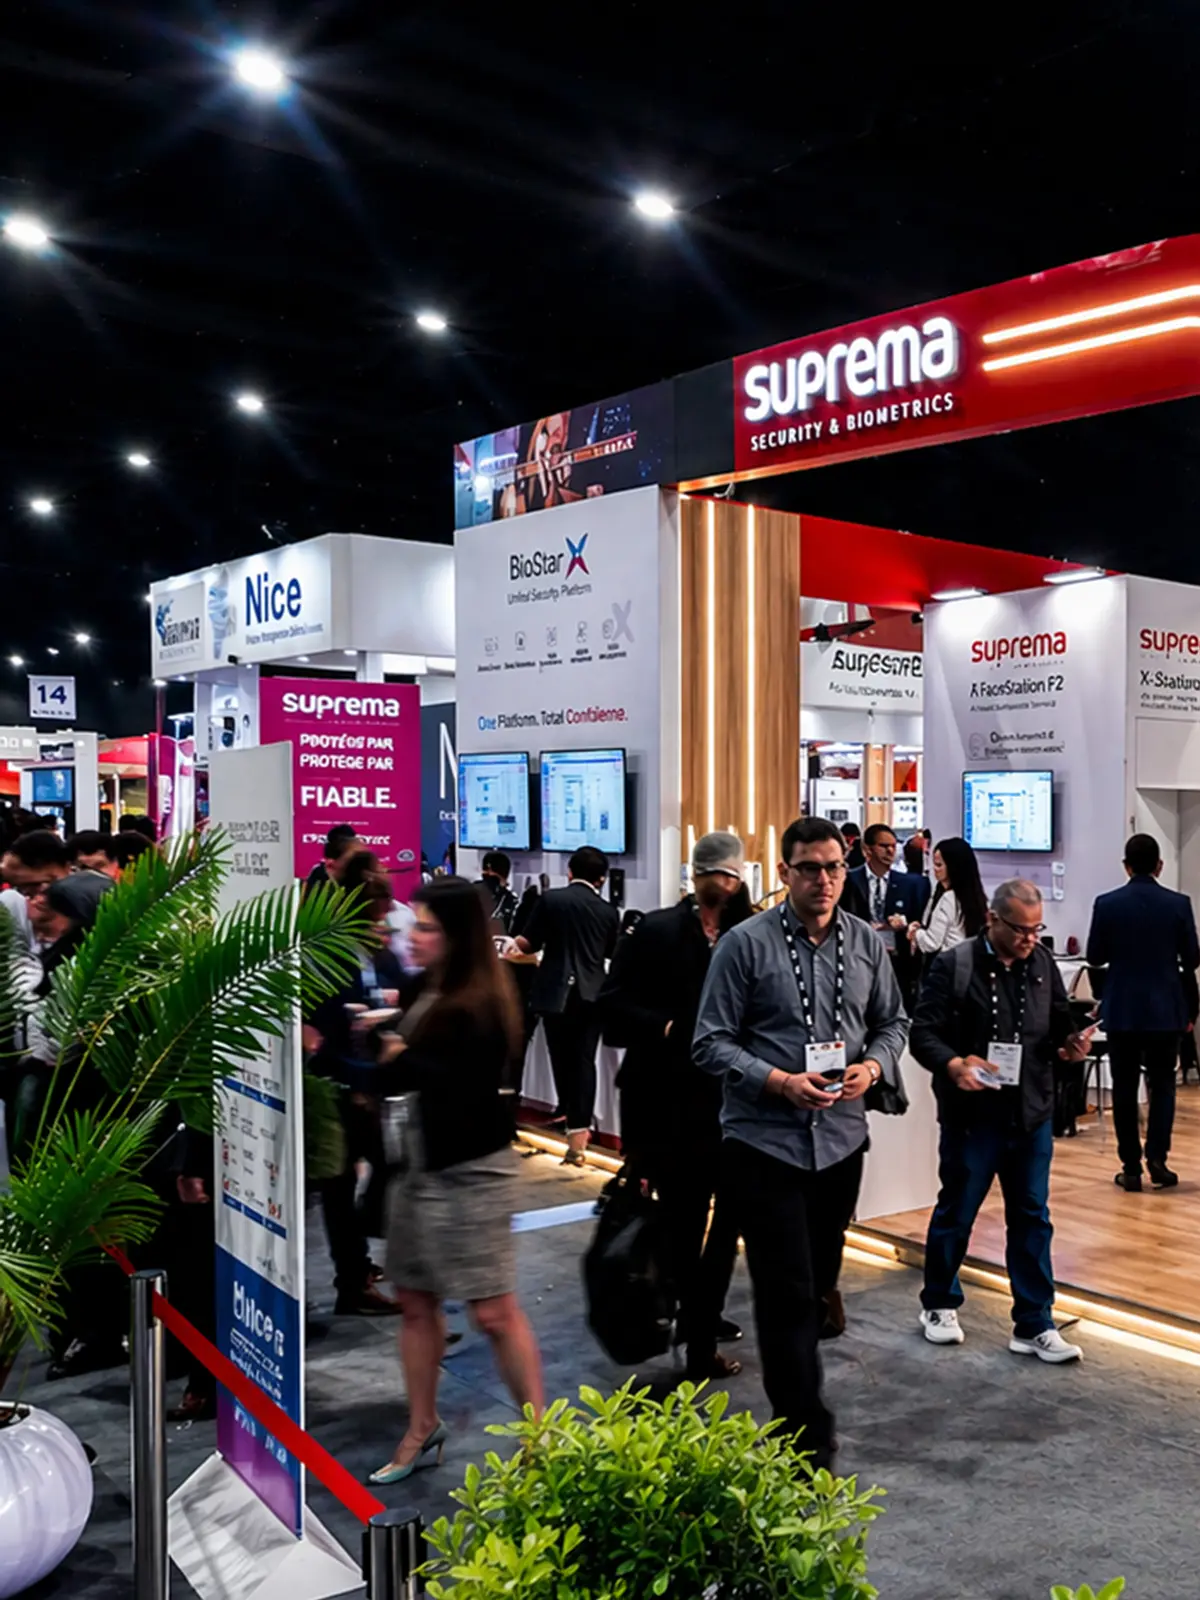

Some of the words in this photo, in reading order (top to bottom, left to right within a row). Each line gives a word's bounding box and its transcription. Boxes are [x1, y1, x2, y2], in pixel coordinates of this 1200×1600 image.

[744, 316, 959, 421] suprema
[751, 422, 822, 451] SECURITY
[829, 418, 840, 435] &
[847, 392, 953, 431] BIOMETRICS
[510, 551, 564, 581] BioStar
[246, 572, 302, 626] Nice
[971, 631, 1066, 663] suprema
[37, 685, 67, 704] 14
[282, 692, 400, 719] suprema
[367, 757, 393, 771] PAR
[301, 786, 397, 809] FIABLE.
